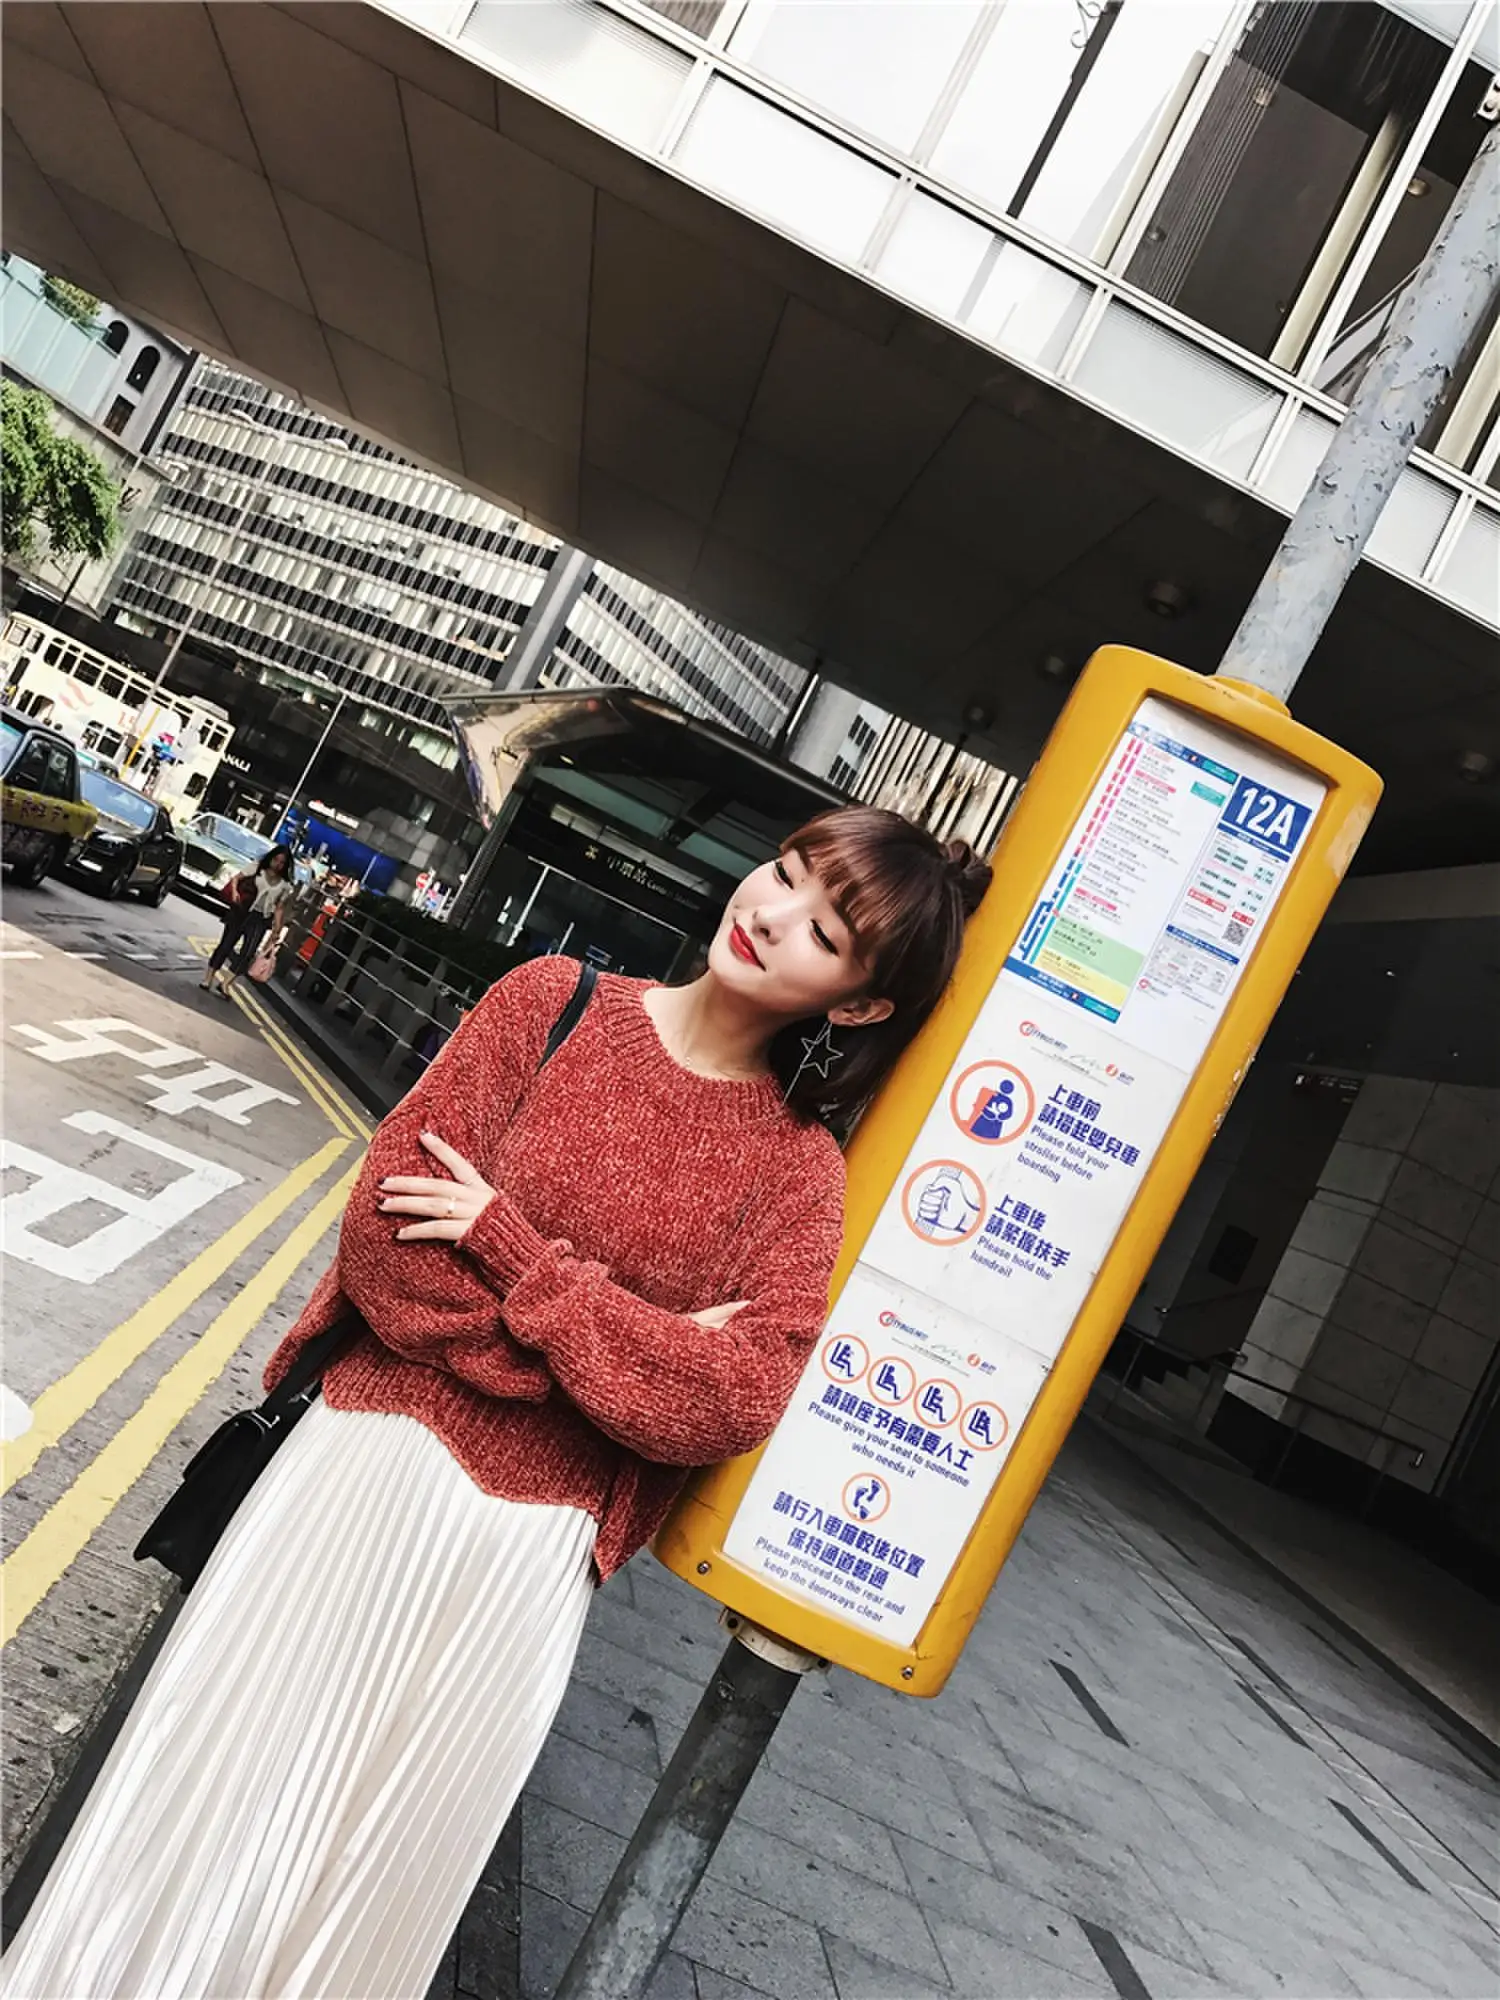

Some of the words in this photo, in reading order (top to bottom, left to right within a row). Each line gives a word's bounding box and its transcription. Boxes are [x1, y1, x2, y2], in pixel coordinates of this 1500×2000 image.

[1235, 787, 1296, 847] 12A
[1047, 1083, 1102, 1122] 上車前
[1024, 1140, 1061, 1164] stroller
[1060, 1156, 1094, 1181] before
[1030, 1124, 1065, 1149] Please
[1064, 1141, 1088, 1160] fold
[1085, 1154, 1110, 1171] your
[1037, 1103, 1141, 1168] 請摺起嬰兒車
[1017, 1151, 1062, 1184] boarding
[994, 1194, 1047, 1233] 上車後
[970, 1249, 1013, 1278] handrail
[976, 1235, 1012, 1261] Please
[1011, 1253, 1037, 1273] hold
[1035, 1266, 1053, 1281] the
[984, 1213, 1071, 1268] 請緊握扶手
[807, 1400, 843, 1426] Please
[842, 1420, 866, 1437] give
[865, 1431, 890, 1448] your
[889, 1443, 913, 1460] seat
[911, 1452, 924, 1466] to
[924, 1459, 970, 1488] someone
[821, 1383, 974, 1472] 請讓座予有需要人士
[851, 1442, 875, 1459] who
[874, 1453, 906, 1474] needs
[906, 1466, 916, 1479] it
[772, 1490, 926, 1579] 請行入車廂較後位置
[755, 1535, 791, 1560] Please
[789, 1555, 833, 1581] proceed
[832, 1573, 844, 1587] to
[844, 1579, 862, 1595] the
[861, 1589, 885, 1605] rear
[883, 1600, 906, 1616] and
[763, 1557, 789, 1579] keep
[789, 1571, 807, 1587] the
[807, 1579, 856, 1610] doorways
[855, 1604, 884, 1623] clear
